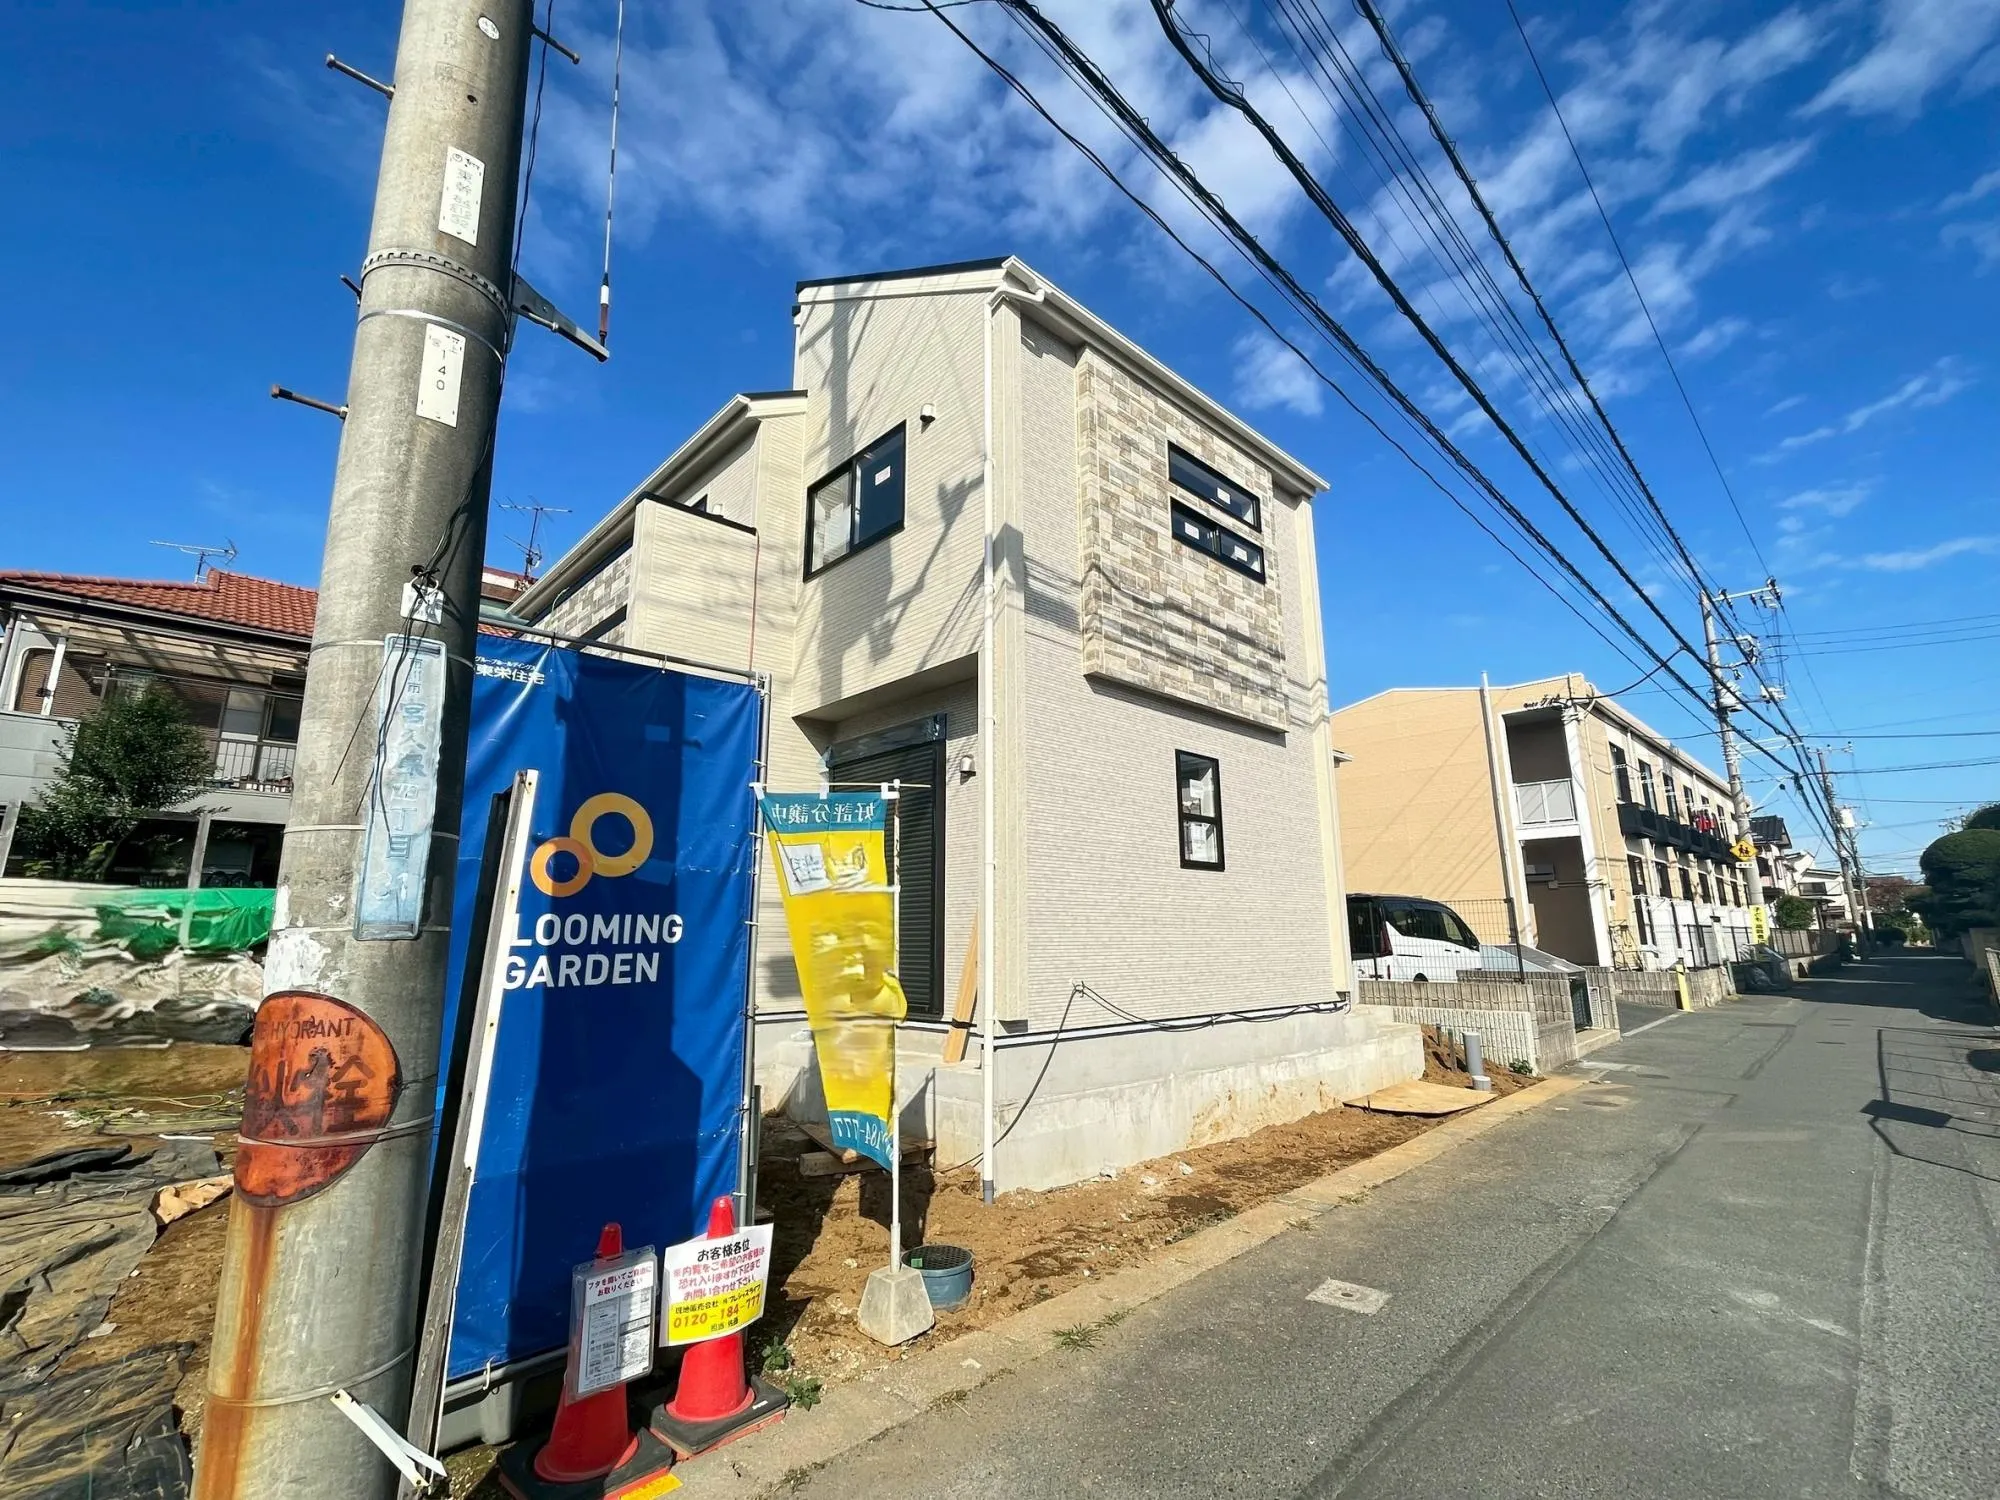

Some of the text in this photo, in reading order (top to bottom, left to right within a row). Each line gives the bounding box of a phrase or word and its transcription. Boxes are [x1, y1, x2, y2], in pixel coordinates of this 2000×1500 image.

[511, 913, 683, 947] LOOMING
[502, 952, 660, 990] GARDEN
[249, 1048, 385, 1134] 火栓
[698, 1238, 750, 1262] お客様各位
